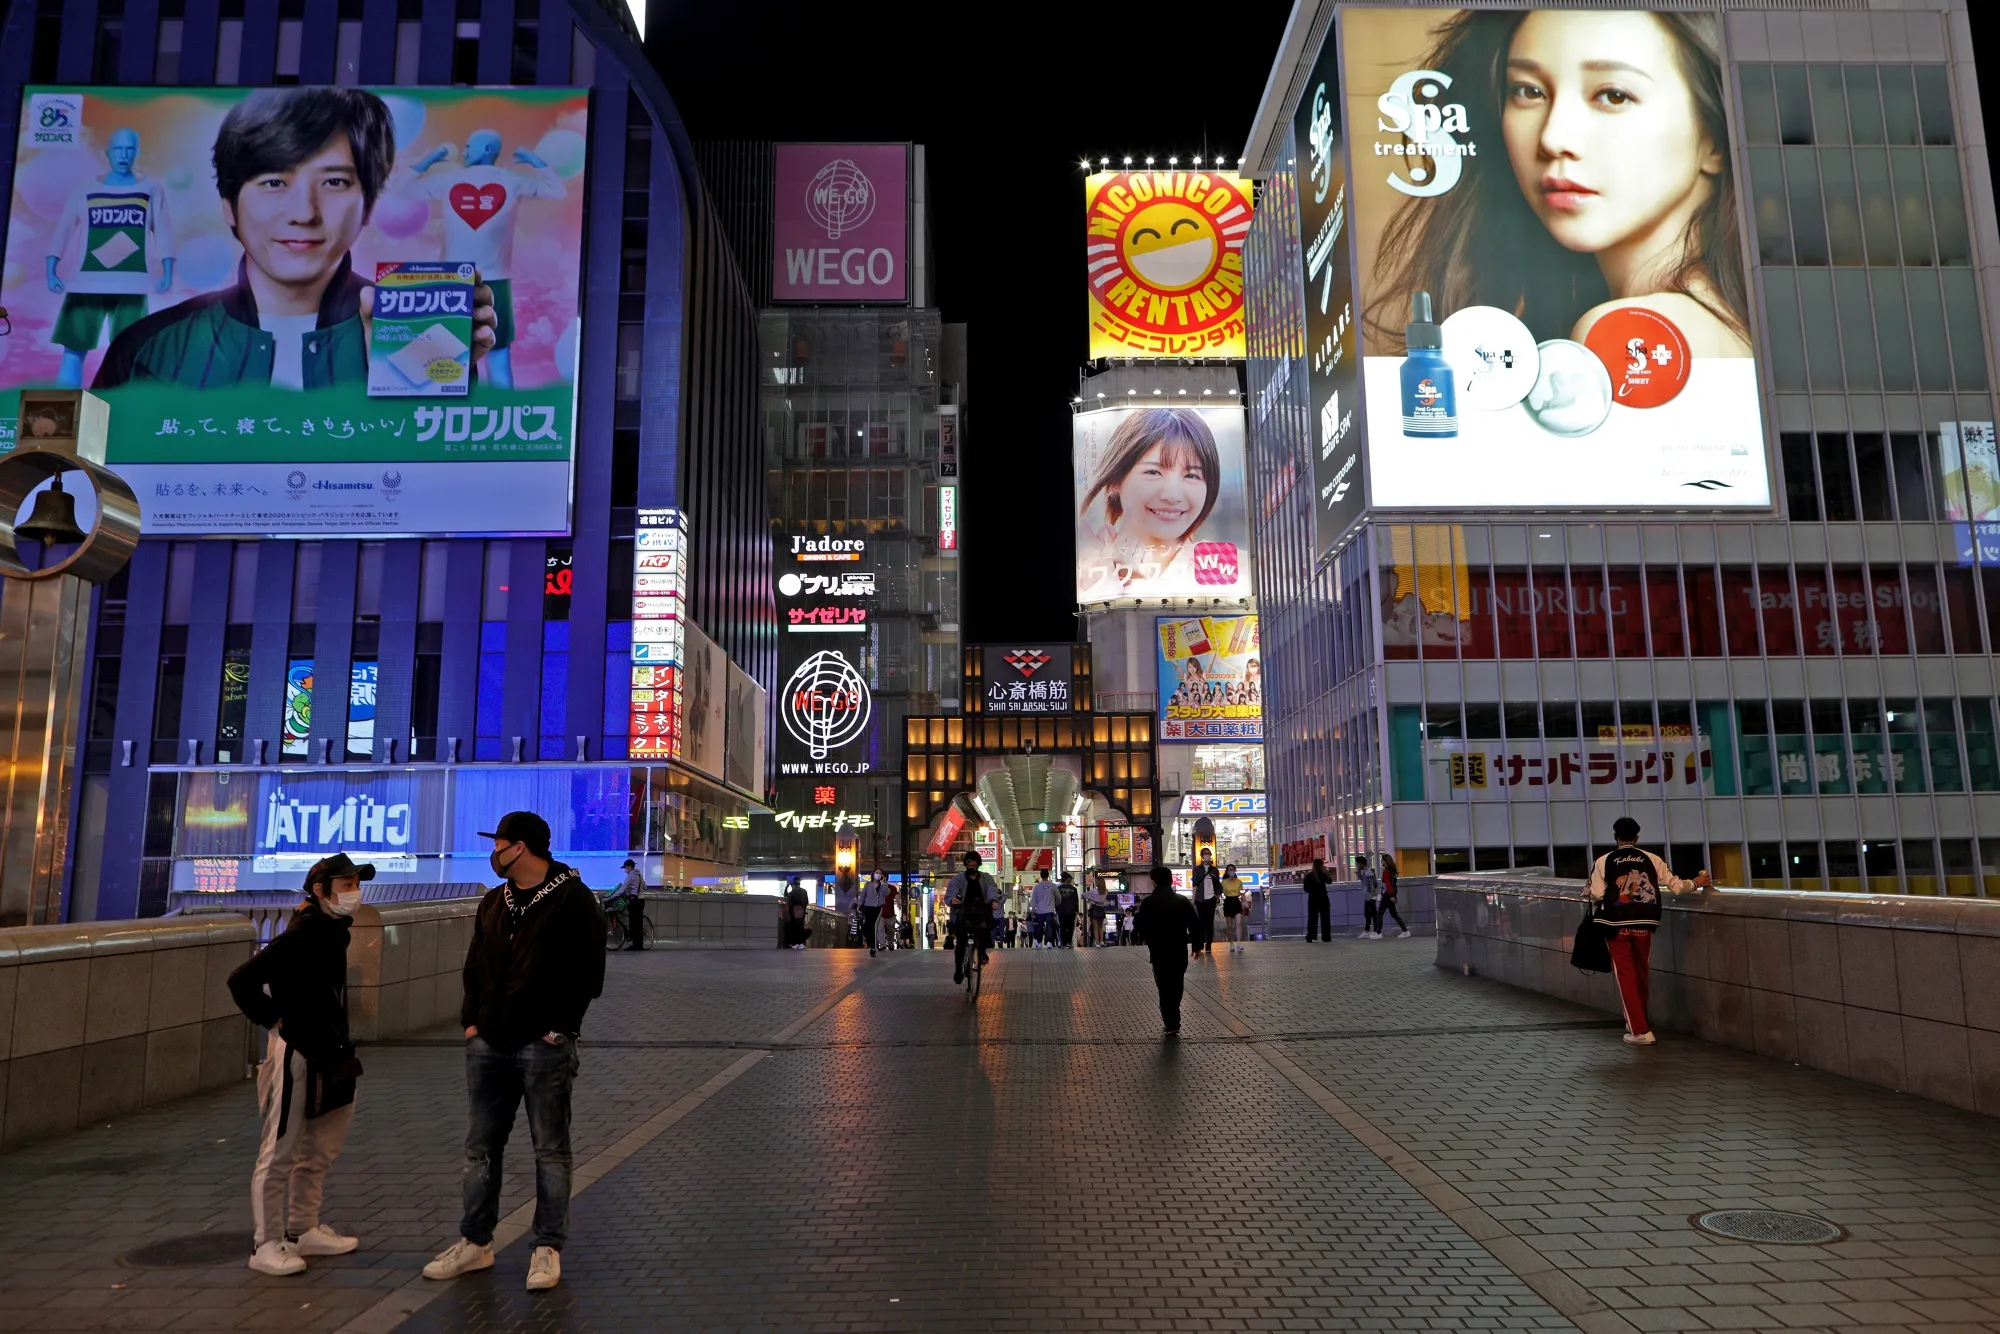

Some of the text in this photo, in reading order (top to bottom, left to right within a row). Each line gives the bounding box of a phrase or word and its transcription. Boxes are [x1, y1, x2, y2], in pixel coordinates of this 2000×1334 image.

[1378, 91, 1471, 143] Spa
[34, 132, 73, 143] サロンパス
[1309, 101, 1332, 161] Spa
[1373, 141, 1477, 156] treatment
[460, 194, 494, 210] 二宮
[1088, 173, 1232, 239] NICONICO
[91, 208, 145, 226] サロンパス
[460, 266, 472, 275] 40
[786, 247, 894, 285] WEGO
[1105, 251, 1244, 326] RENTACAR
[380, 290, 468, 313] サロンパス
[1093, 311, 1245, 354] ニコニコレンタカ
[1315, 302, 1351, 372] AIRARE
[1418, 383, 1437, 396] Spa
[414, 404, 558, 441] サロンパス
[943, 424, 955, 455] プリ機
[944, 464, 954, 472] 7F
[1332, 453, 1356, 490] corporation
[155, 481, 268, 497] 貼るを、未来へ。
[312, 479, 374, 491] Hisamitsu
[791, 535, 865, 553] J'adore
[943, 530, 953, 549] 6F
[642, 555, 670, 567] TKP
[1430, 585, 1628, 616] SUNDRUG
[1742, 585, 1943, 614] Tax Free Shop
[788, 607, 866, 624] サイゼリヤ
[1816, 619, 1884, 649] 免税
[795, 690, 859, 711] WE GO
[988, 680, 1067, 701] 心斎橋筋
[653, 666, 671, 748] インターネット
[988, 702, 1007, 711] SHIN
[1008, 702, 1021, 711] SAI
[1166, 704, 1262, 720] スタッフ大募集中
[631, 702, 650, 748] コミック
[1164, 721, 1182, 737] 薬
[782, 763, 870, 774] WWW.WEGO.JP
[1452, 751, 1676, 787] 薬 サンドラッグ
[814, 785, 836, 804] 薬
[1188, 795, 1203, 811] 薬
[774, 810, 874, 833] マツモトキヨシ
